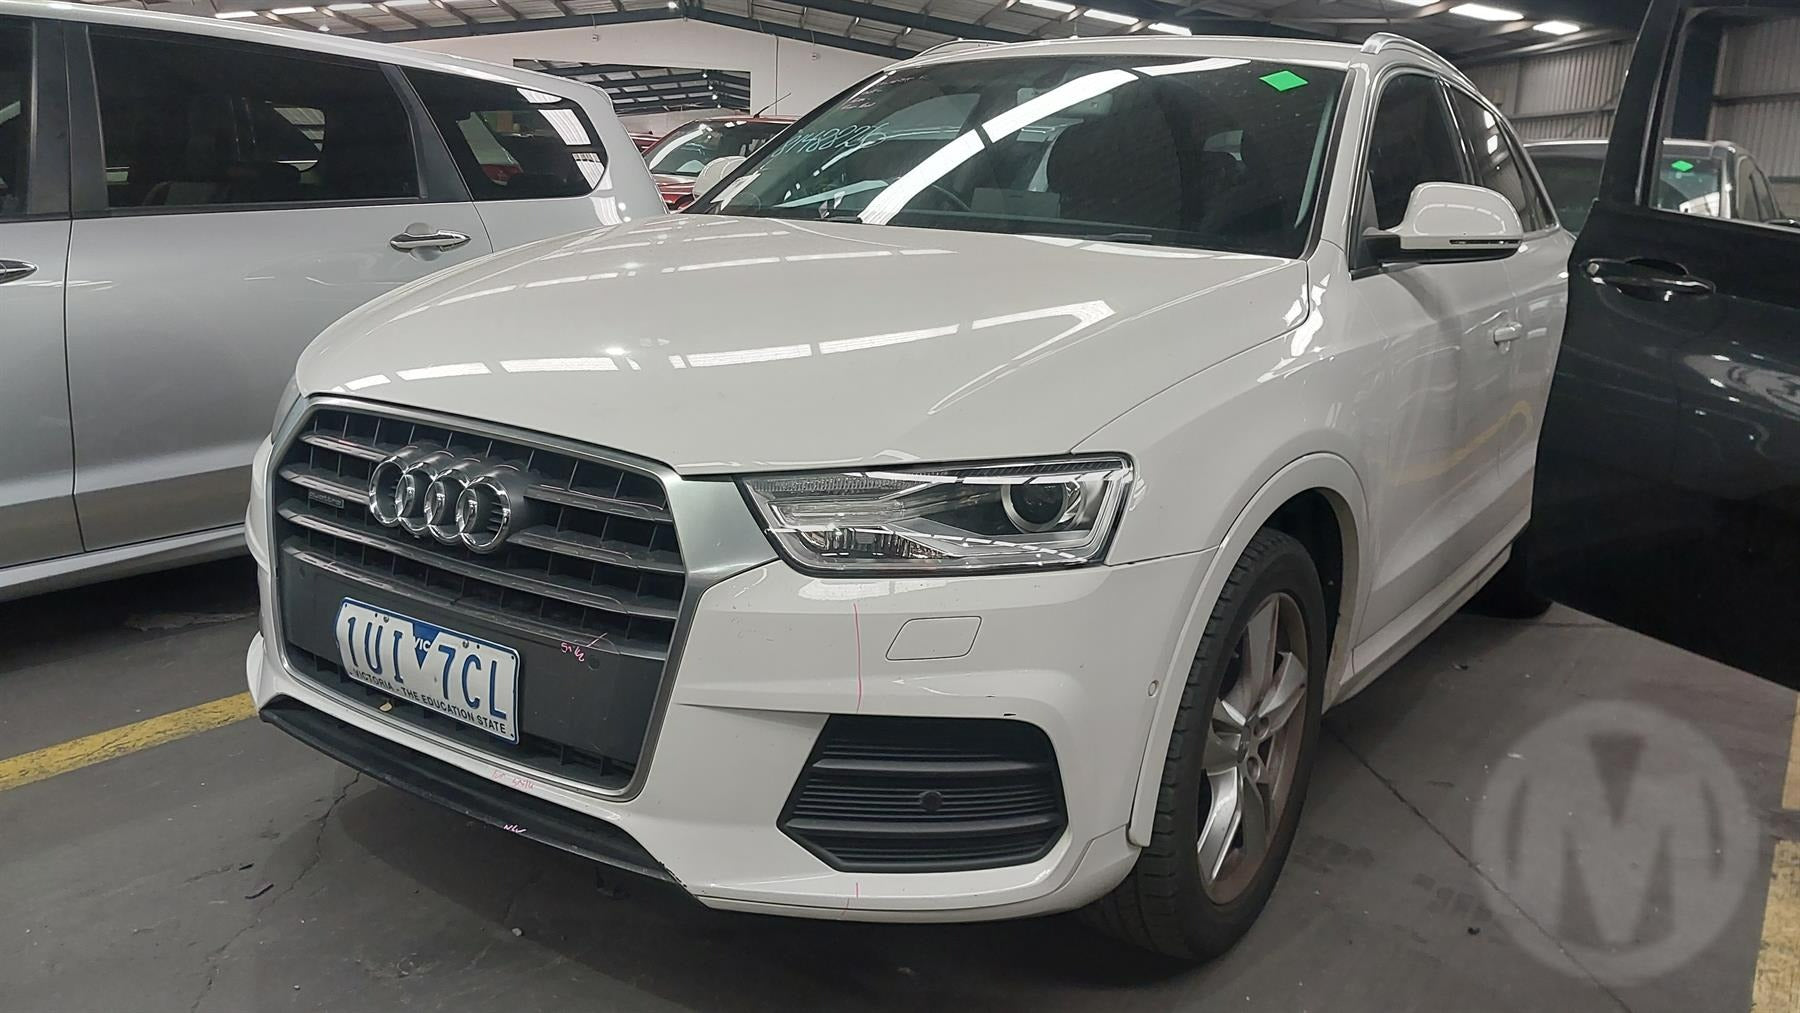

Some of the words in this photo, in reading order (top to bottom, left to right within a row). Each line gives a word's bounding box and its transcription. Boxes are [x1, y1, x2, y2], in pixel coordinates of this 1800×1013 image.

[413, 635, 431, 652] VIC
[353, 667, 394, 691] VICTORIA
[401, 686, 420, 701] THE
[421, 694, 474, 722] EDUCATION
[477, 714, 507, 734] STATE
